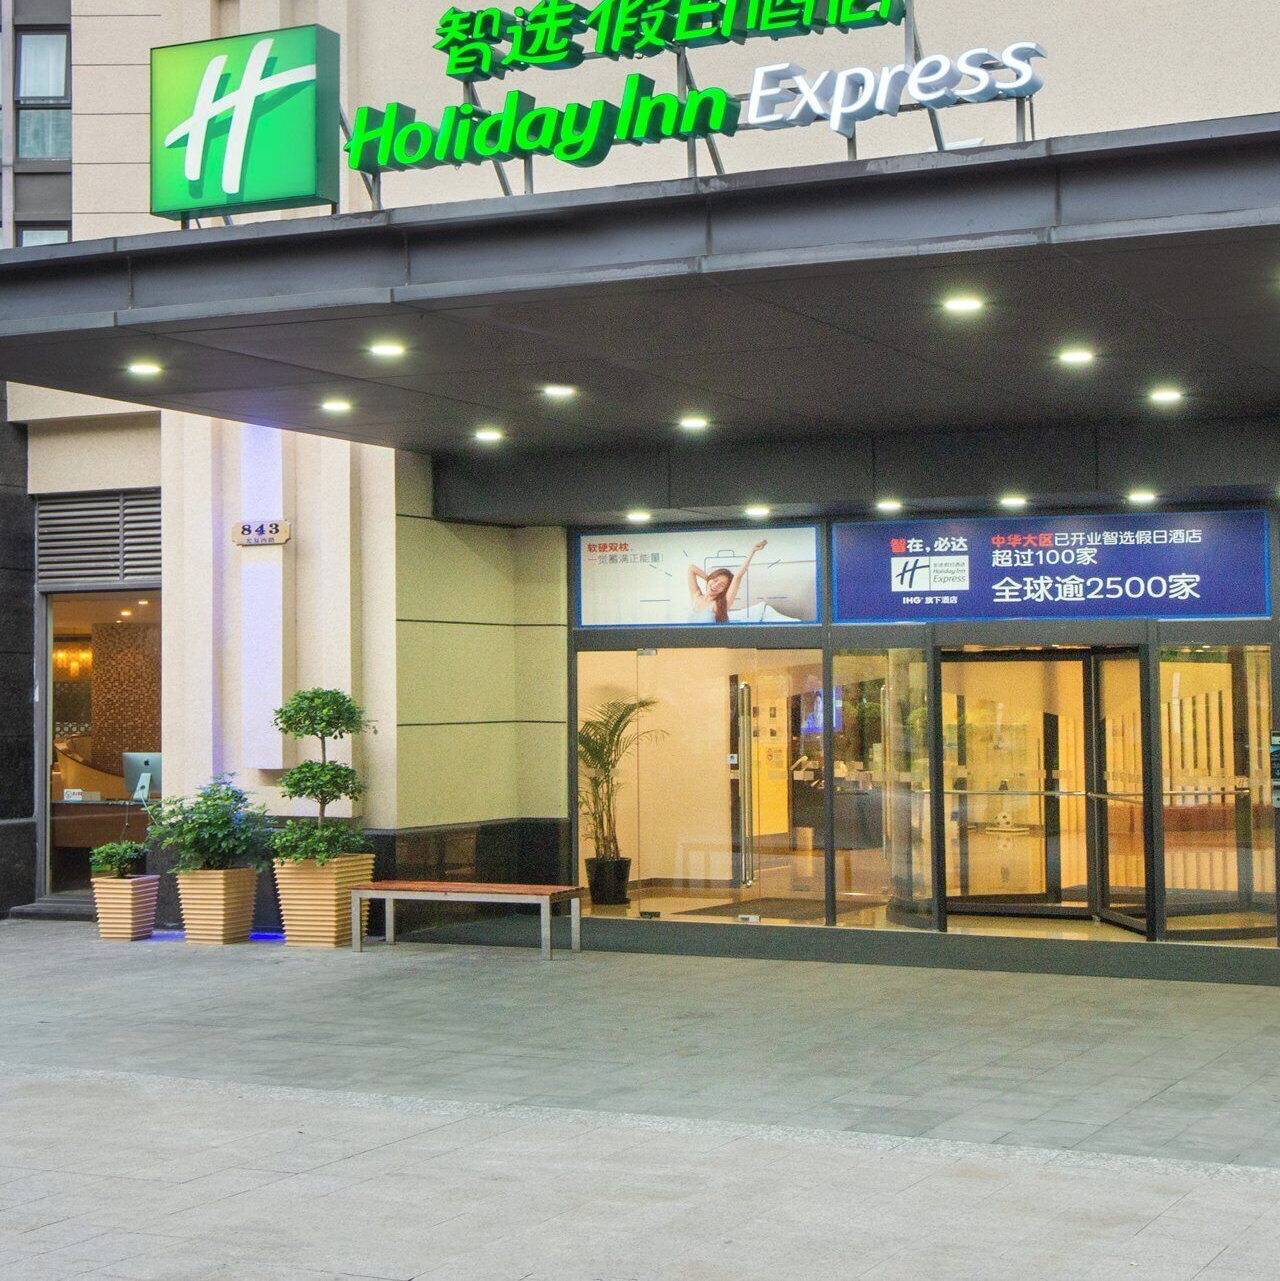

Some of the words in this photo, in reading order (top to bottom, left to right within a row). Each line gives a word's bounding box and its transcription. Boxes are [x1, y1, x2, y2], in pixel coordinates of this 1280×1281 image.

[344, 89, 608, 168] Holiday
[615, 73, 733, 142] Inn
[748, 42, 1046, 137] Express
[165, 38, 317, 194] H
[241, 523, 280, 536] 843
[991, 529, 1202, 548] 中华大区已开业智选假日酒店
[991, 547, 1098, 567] 超过100家
[933, 575, 966, 583] Express
[991, 573, 1201, 602] 全球逾2500家
